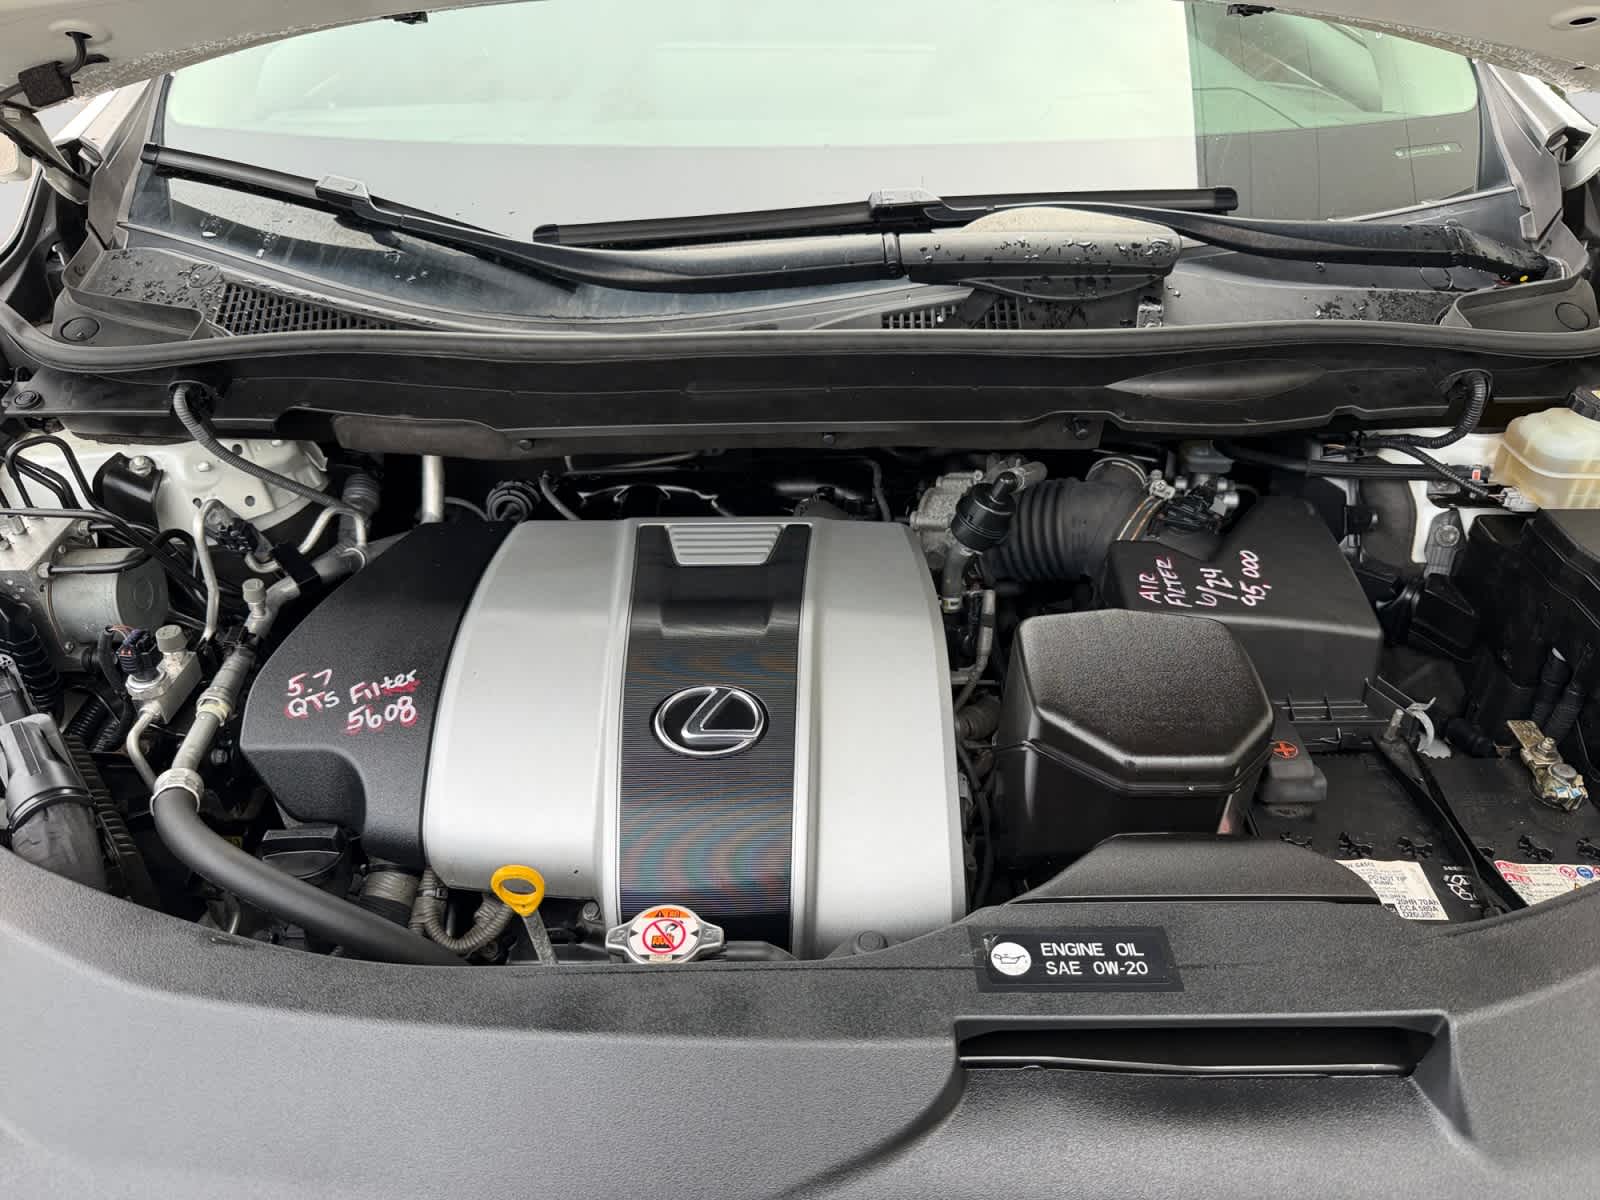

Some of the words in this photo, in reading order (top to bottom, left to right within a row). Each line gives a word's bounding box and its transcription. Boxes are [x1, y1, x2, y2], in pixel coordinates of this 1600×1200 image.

[1138, 572, 1162, 604] AIR
[1155, 556, 1193, 608] FILTER
[1195, 567, 1238, 607] 6/24
[287, 668, 333, 697] 5.7
[349, 669, 418, 705] Filter
[346, 695, 417, 732] 5608
[1040, 942, 1105, 957] ENGINE
[1115, 942, 1145, 957] OIL
[1045, 960, 1083, 976] SAE
[1092, 960, 1149, 976] 0W-20
